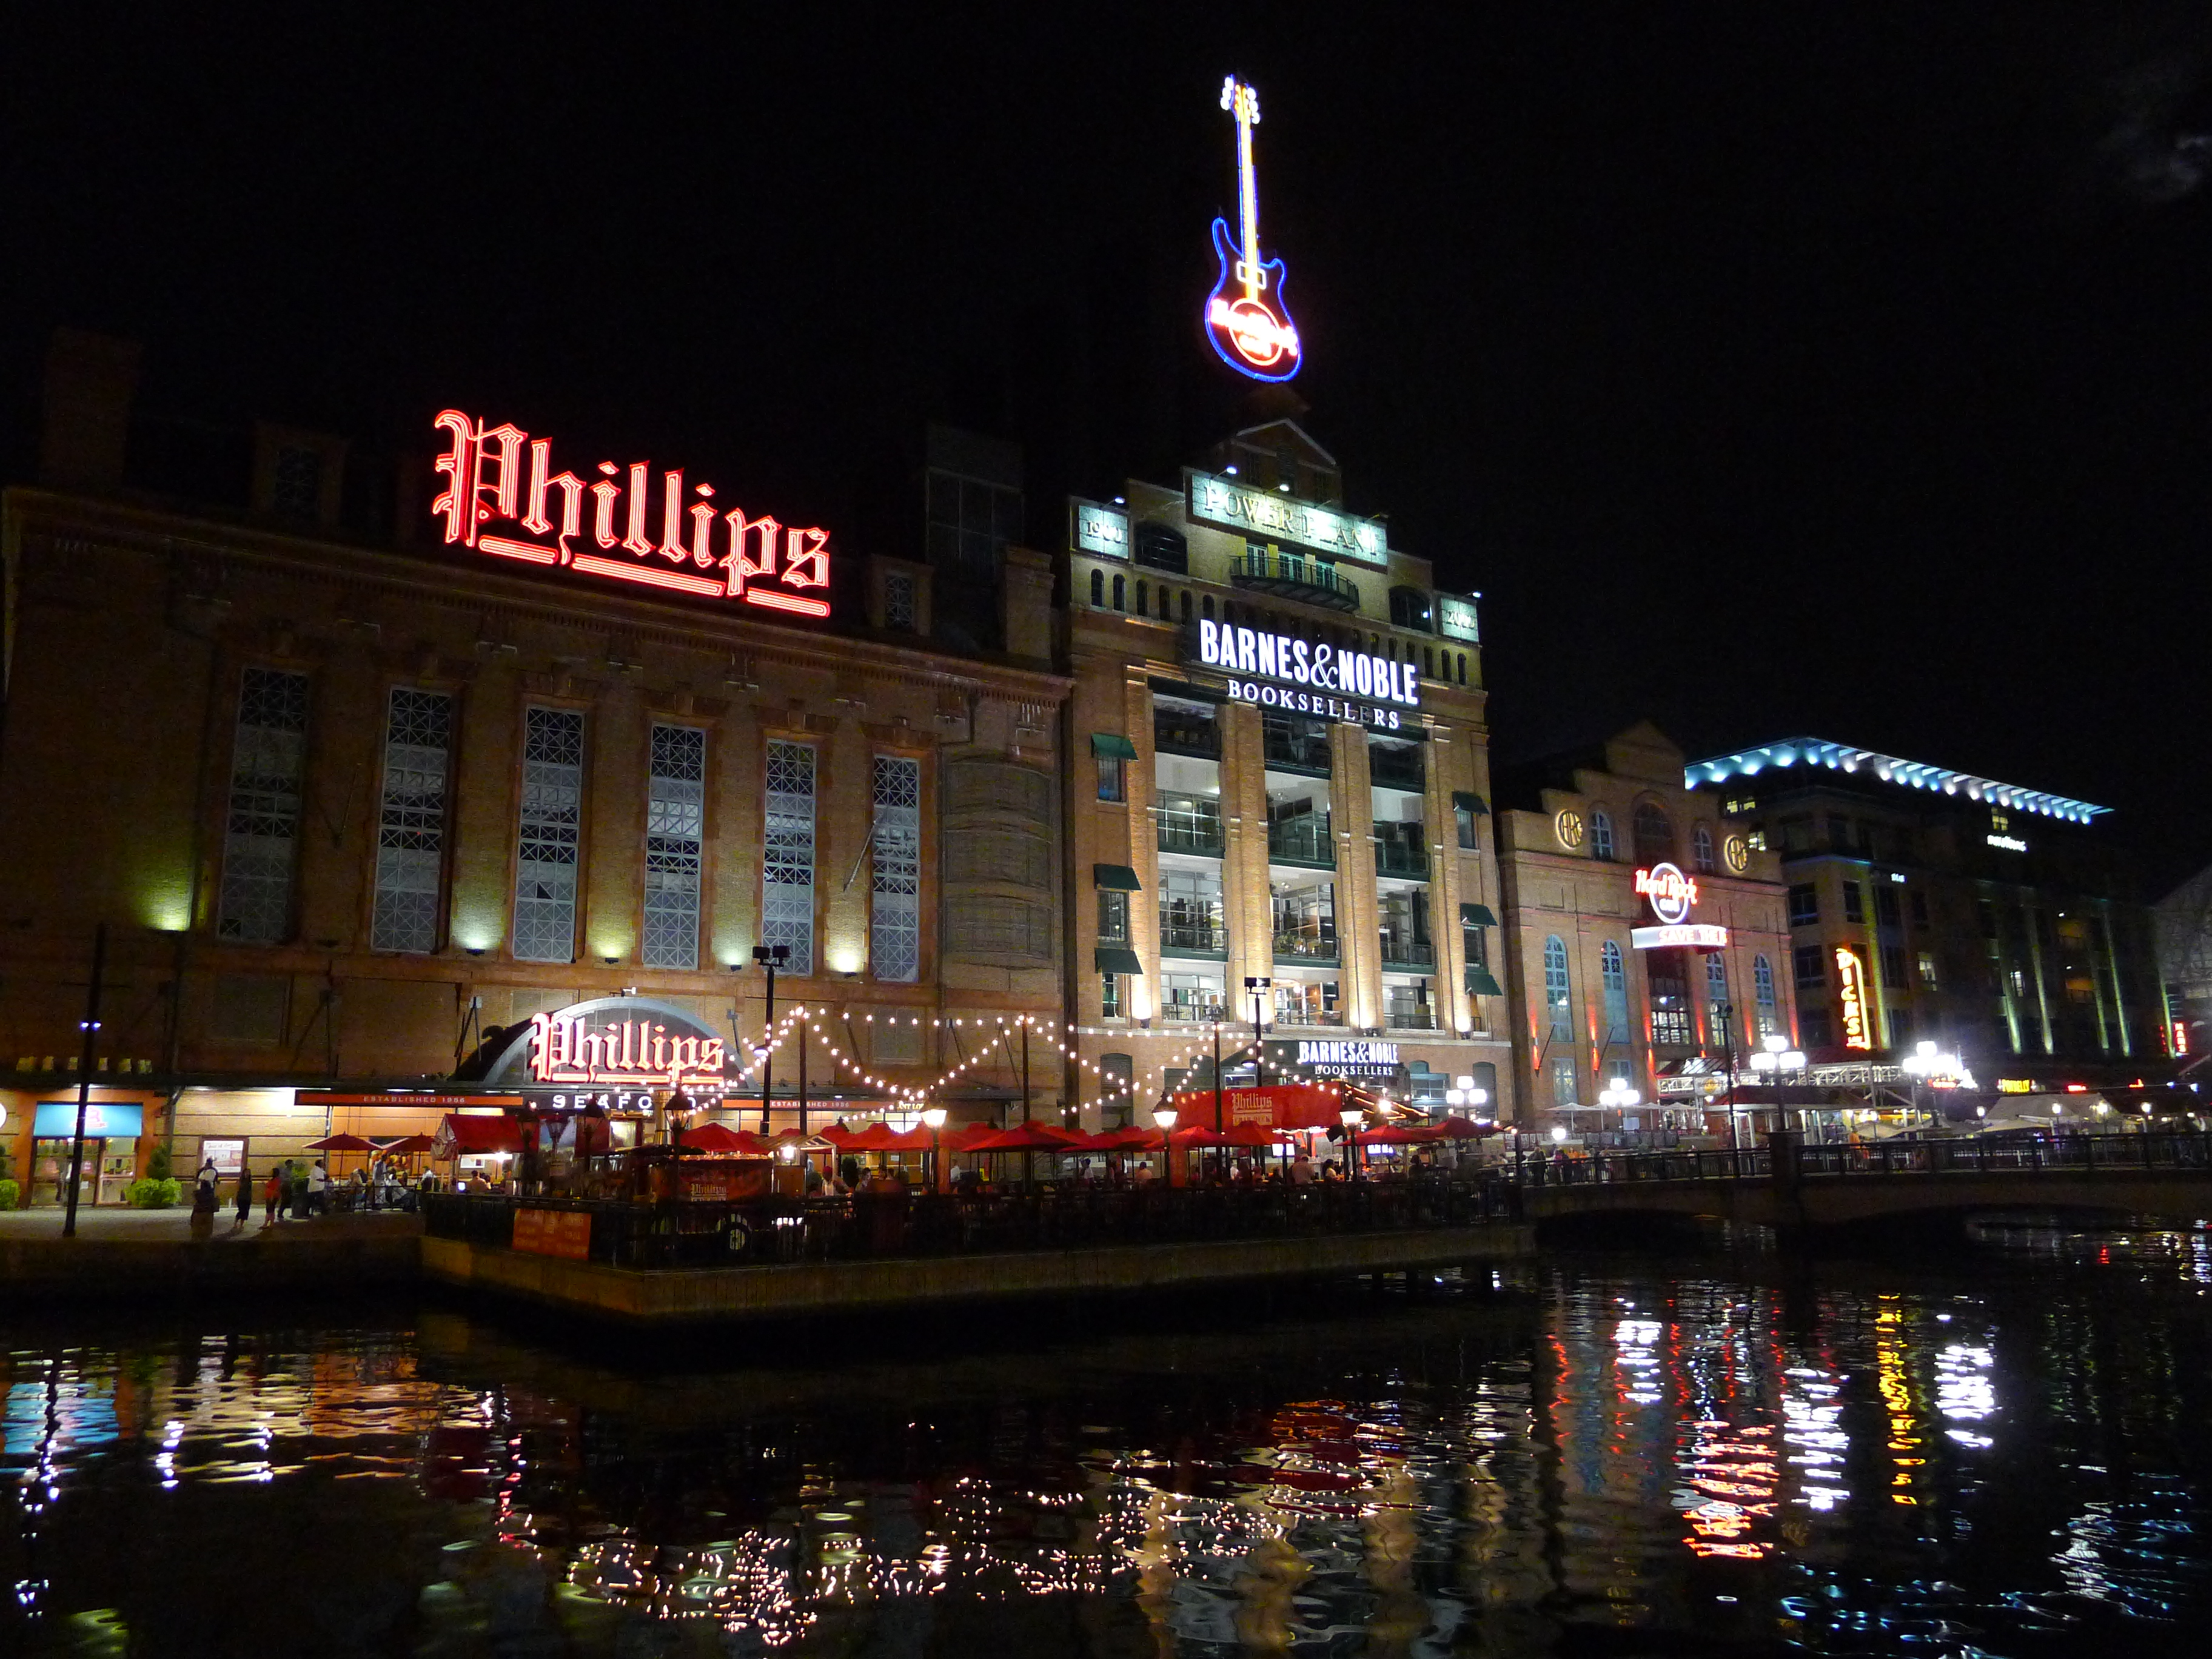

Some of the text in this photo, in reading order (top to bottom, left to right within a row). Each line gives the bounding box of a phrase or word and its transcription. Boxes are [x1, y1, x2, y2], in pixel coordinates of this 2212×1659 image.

[432, 409, 830, 597] Phillips
[1204, 486, 1376, 555] POWER PLANT
[1227, 679, 1399, 729] BOOKSELLERS
[1635, 869, 1698, 905] Hard Rock
[1658, 929, 1694, 943] SAVE
[531, 1012, 725, 1082] Phillips
[1315, 1065, 1393, 1076] BOOKSELLERS
[553, 1094, 696, 1109] SEAFO
[1232, 1093, 1272, 1112] Phillips
